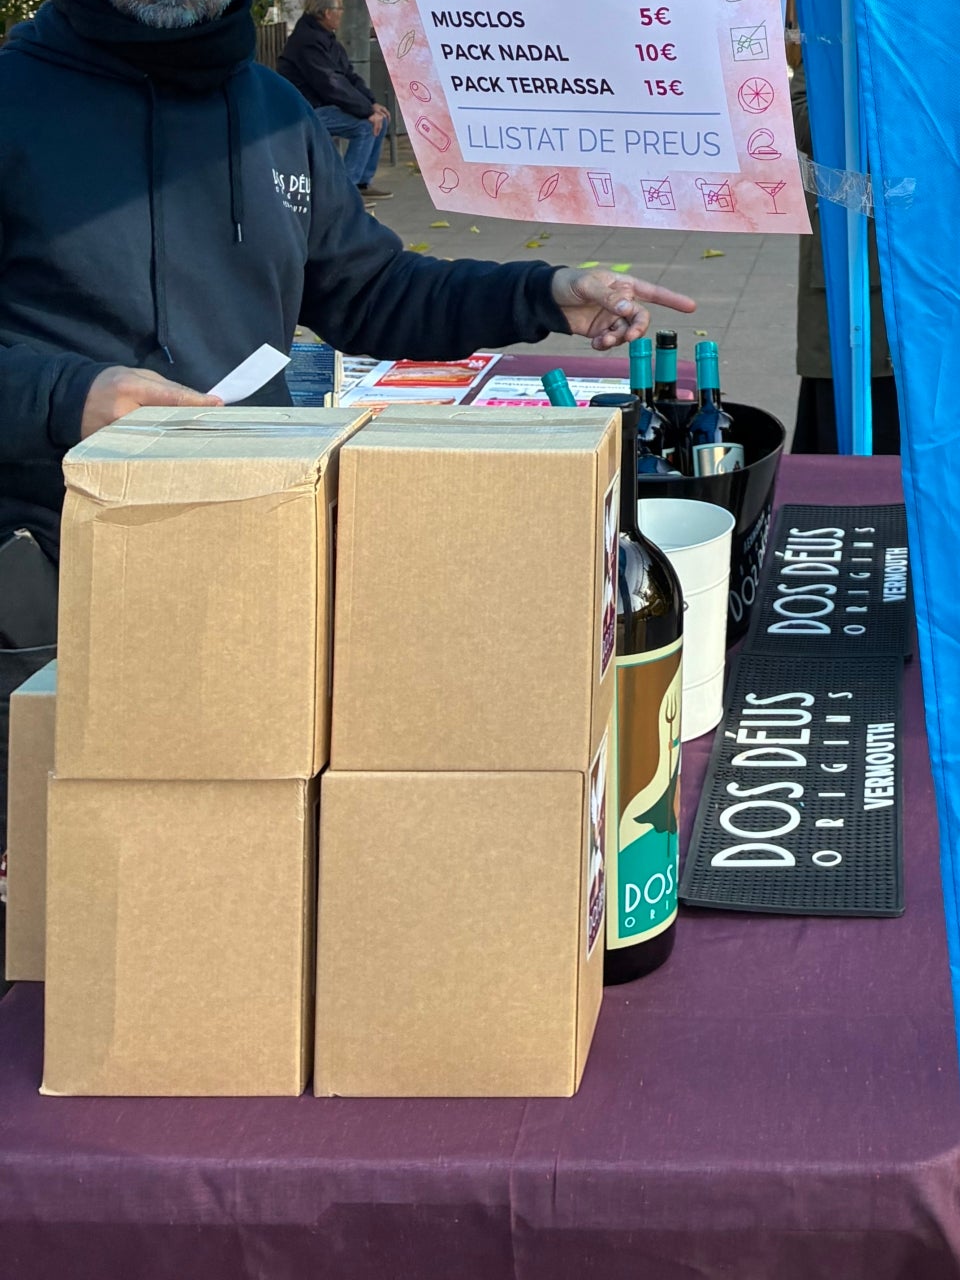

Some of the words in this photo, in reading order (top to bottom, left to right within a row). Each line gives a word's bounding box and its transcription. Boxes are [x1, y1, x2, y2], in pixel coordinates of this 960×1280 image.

[431, 10, 525, 28] MUSCLOS
[639, 7, 671, 26] 5€
[440, 43, 495, 61] PACK
[498, 44, 569, 62] NADAL
[635, 43, 677, 62] 10€
[450, 75, 504, 93] PACK
[507, 76, 615, 96] TERRASSA
[644, 79, 685, 96] 15€
[467, 124, 570, 152] LLISTAT
[579, 128, 616, 153] DE
[625, 129, 721, 158] PREUS
[775, 527, 845, 576] DÉUS
[882, 547, 908, 602] VERMOUTH
[767, 583, 838, 634] DOS
[725, 692, 815, 767] DÉUS
[863, 722, 896, 811] VERMOUTH
[711, 781, 804, 867] DOS
[625, 864, 674, 913] DOS
